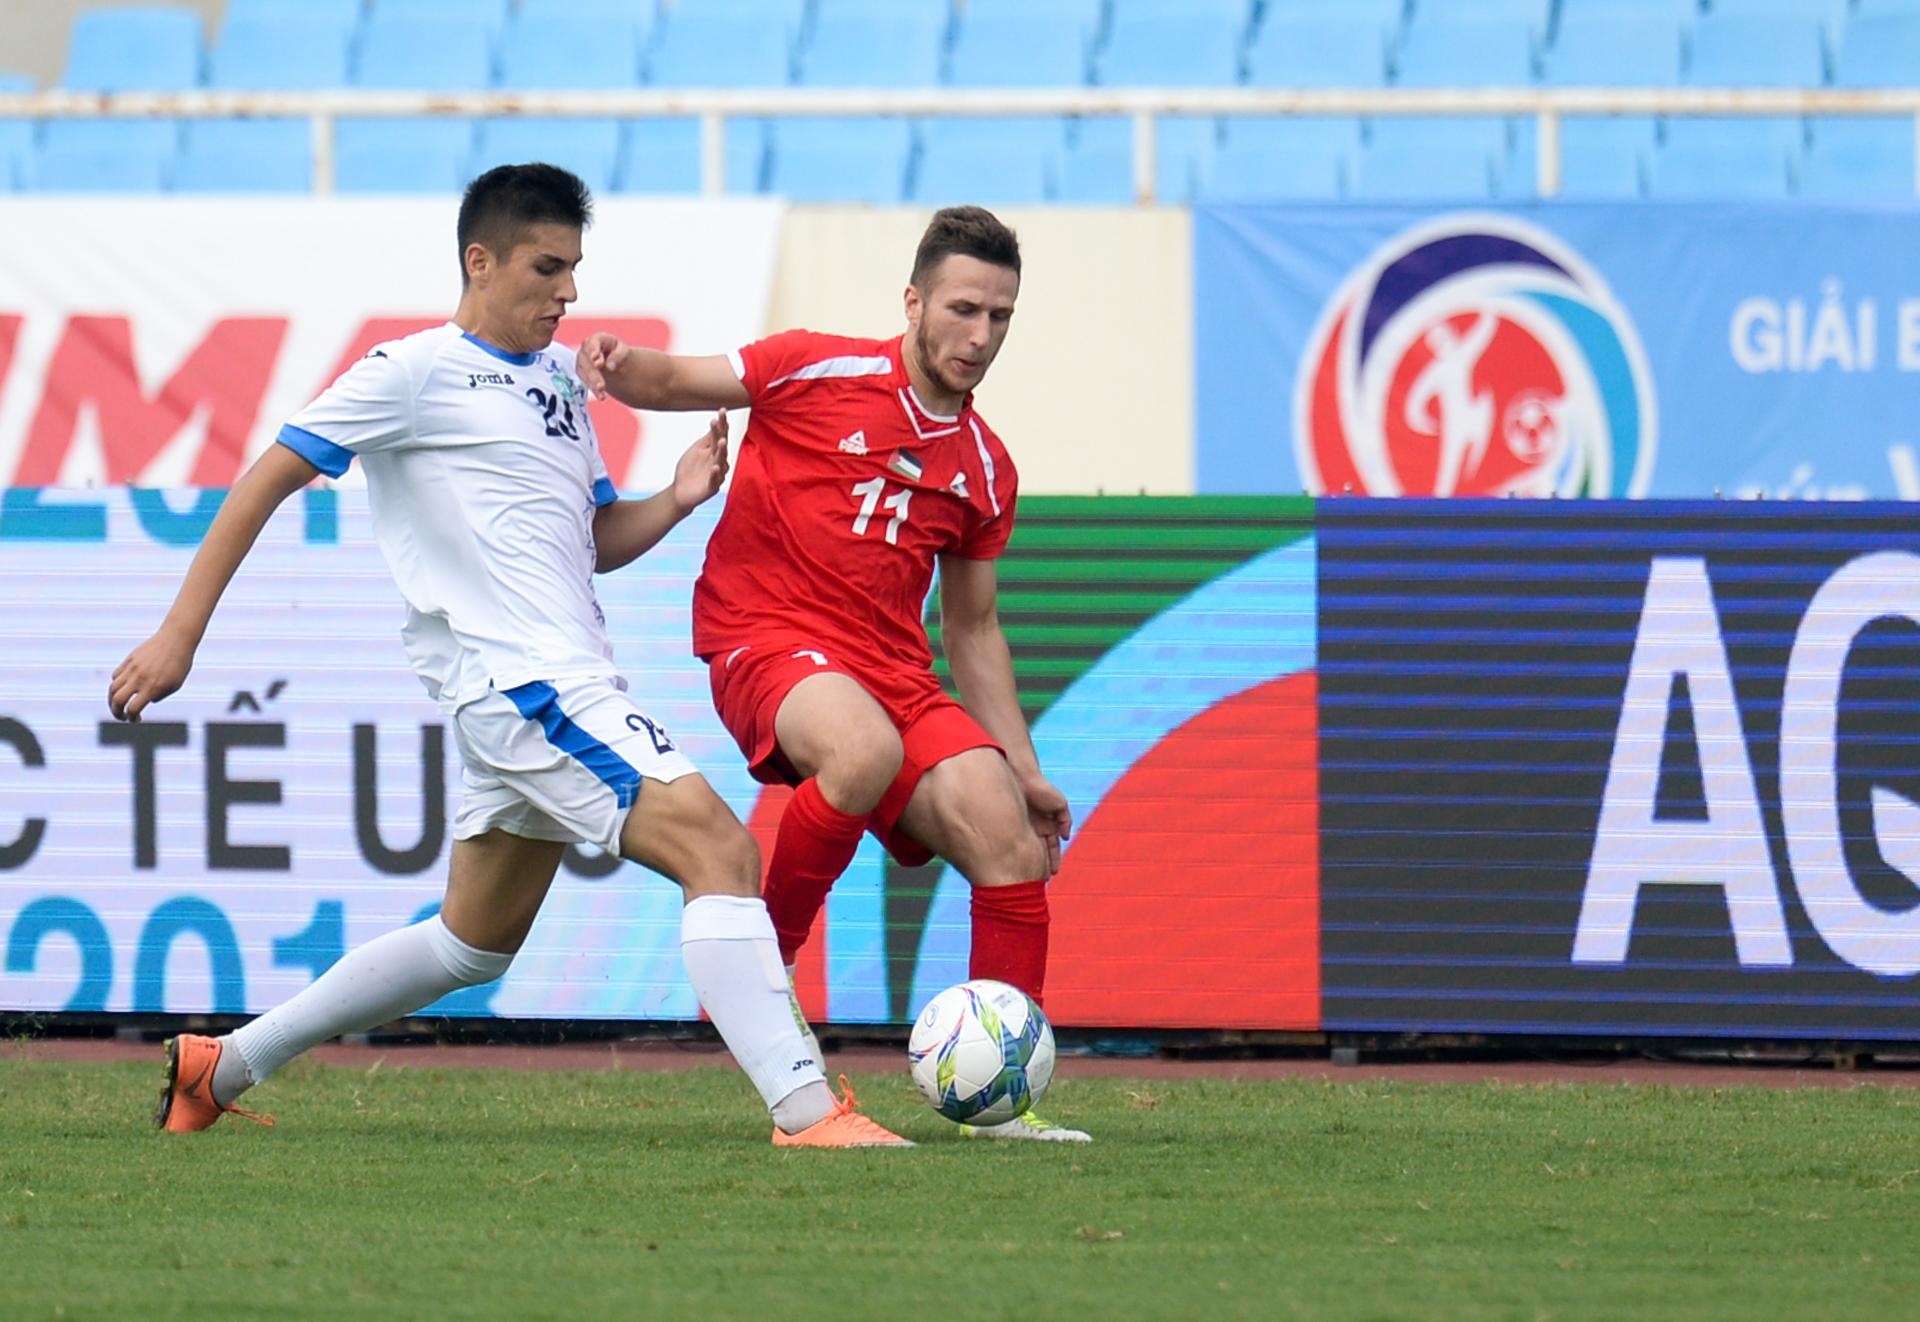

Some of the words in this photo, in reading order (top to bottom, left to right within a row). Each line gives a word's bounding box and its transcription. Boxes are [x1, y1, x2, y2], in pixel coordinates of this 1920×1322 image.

[851, 476, 914, 546] 11
[98, 680, 291, 870] TẾ
[1571, 550, 1920, 978] AG
